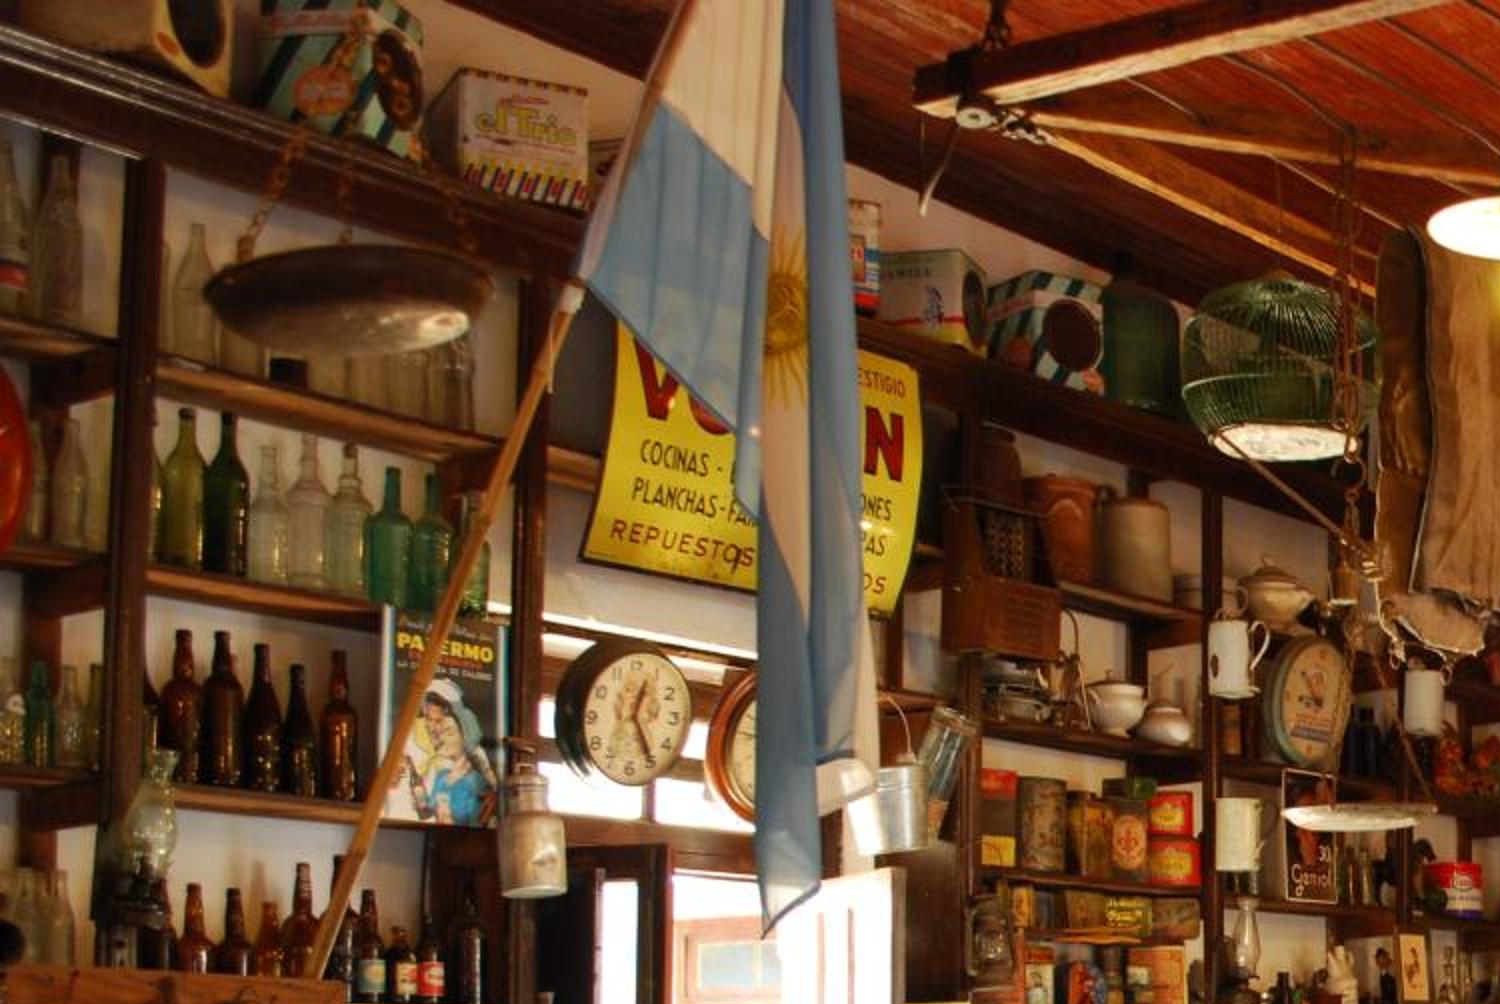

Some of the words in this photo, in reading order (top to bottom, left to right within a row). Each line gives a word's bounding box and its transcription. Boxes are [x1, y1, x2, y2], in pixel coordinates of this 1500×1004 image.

[640, 438, 710, 477] COCINAS
[610, 518, 755, 566] REPUESTOS
[396, 631, 494, 664] PAERMO
[663, 687, 675, 701] 2
[586, 710, 598, 725] 9
[668, 711, 680, 726] 3
[660, 737, 672, 752] 4
